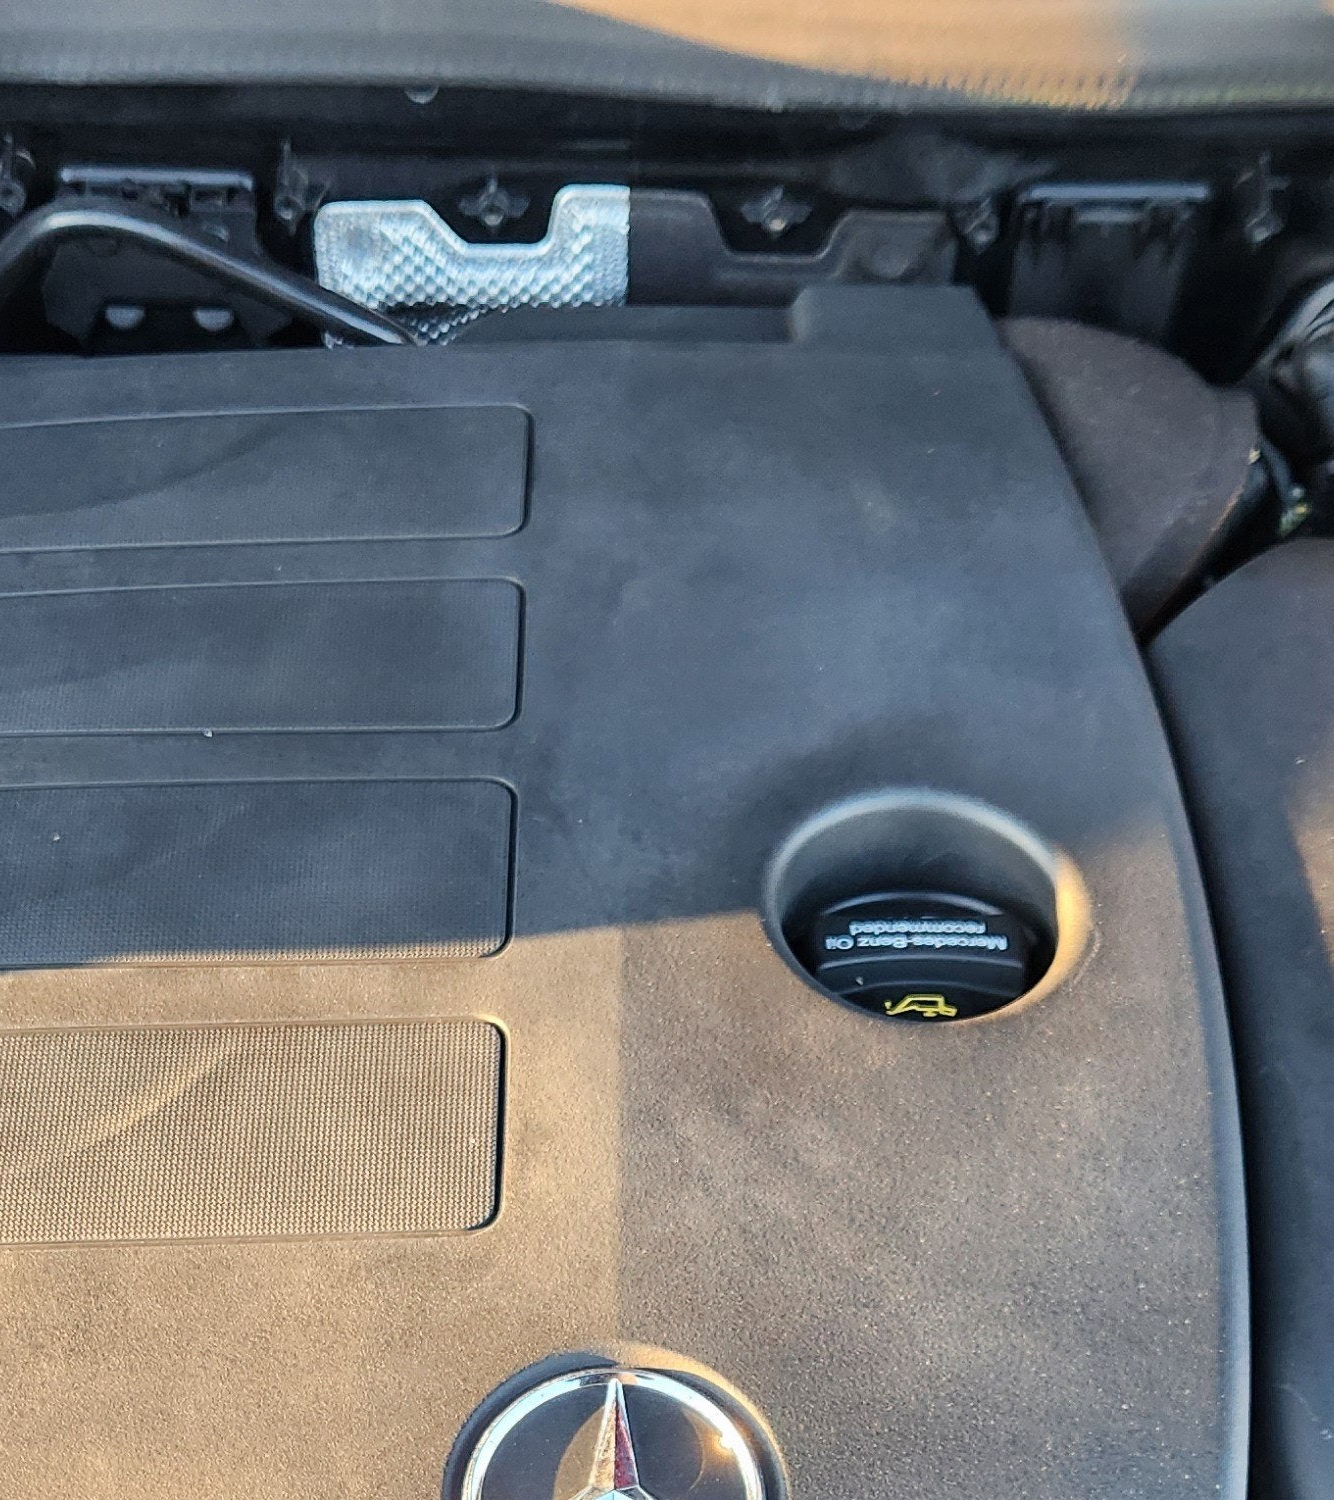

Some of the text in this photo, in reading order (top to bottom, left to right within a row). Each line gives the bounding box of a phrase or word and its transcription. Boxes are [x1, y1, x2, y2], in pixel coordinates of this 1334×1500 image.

[849, 920, 986, 935] recommended
[825, 934, 1008, 950] Mercedes-Benz Oil
